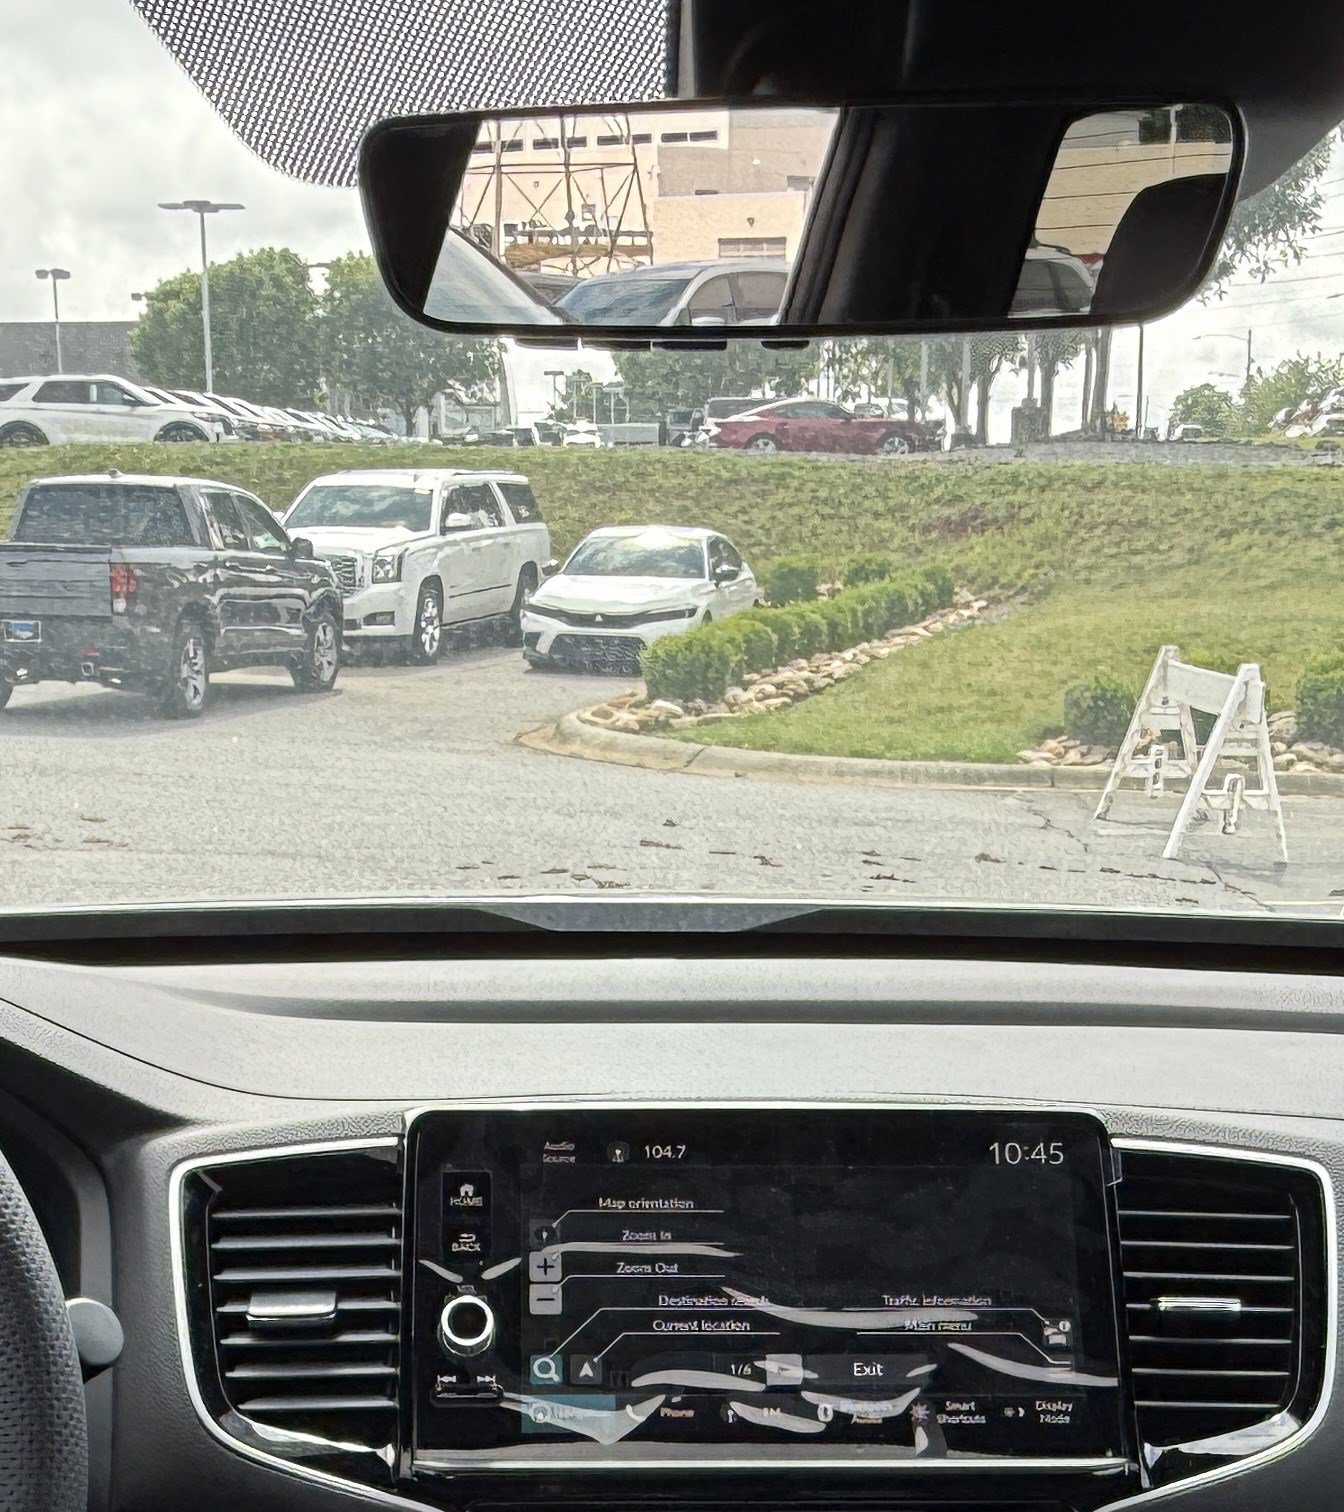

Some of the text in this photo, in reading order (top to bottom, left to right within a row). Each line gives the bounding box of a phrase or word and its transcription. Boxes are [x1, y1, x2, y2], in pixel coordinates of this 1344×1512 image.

[644, 1144, 687, 1159] 104.7
[988, 1142, 1065, 1166] 10:45
[599, 1197, 625, 1209] Map
[622, 1230, 657, 1241] Zoom
[616, 1262, 651, 1273] Zoom
[701, 1320, 750, 1331] location
[731, 1363, 752, 1375] 1/6
[854, 1363, 884, 1377] Exit
